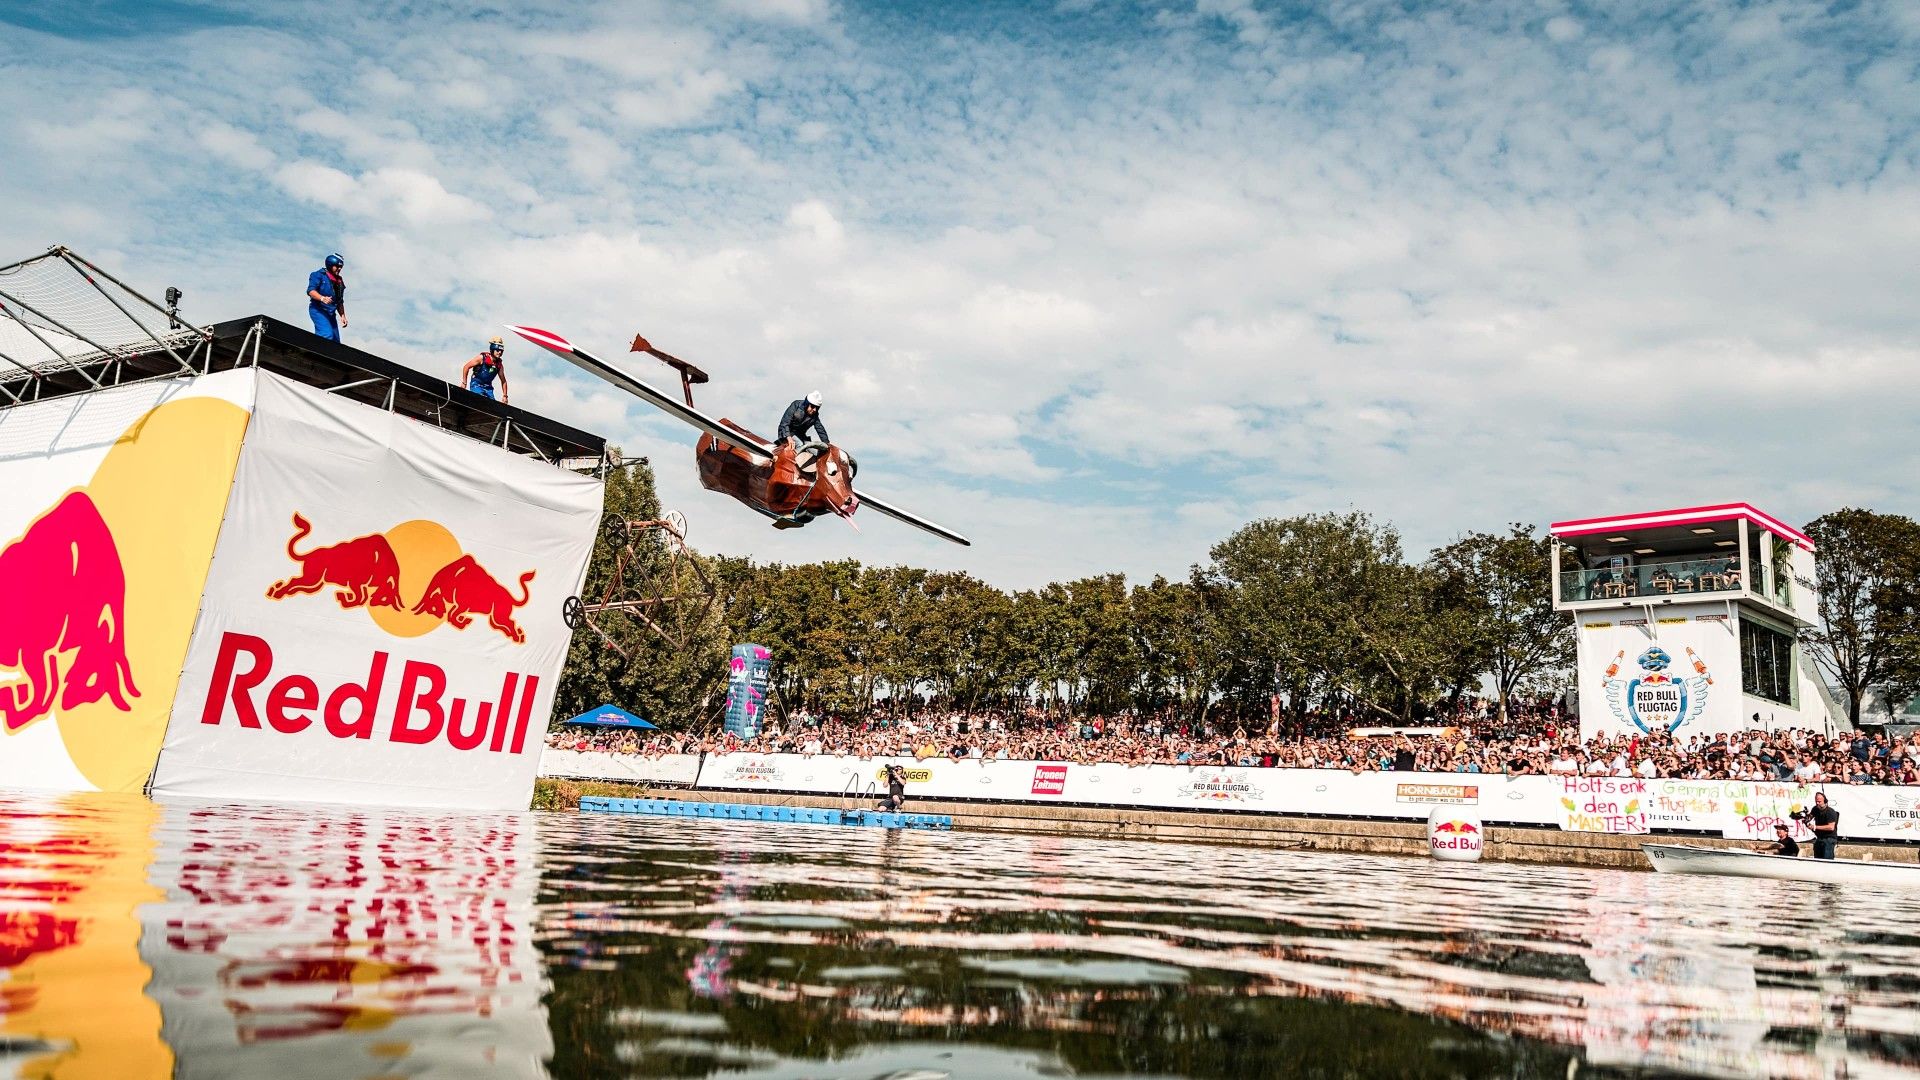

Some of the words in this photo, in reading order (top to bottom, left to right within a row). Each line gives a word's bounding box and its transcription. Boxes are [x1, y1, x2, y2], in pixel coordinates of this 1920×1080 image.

[201, 631, 389, 740] Red
[389, 659, 540, 754] Bull
[1637, 691, 1654, 701] RED
[1656, 690, 1678, 700] BULL
[1638, 702, 1678, 712] FLUGTAG
[879, 770, 929, 780] PNGER
[1035, 769, 1066, 780] Kronen
[1033, 780, 1064, 791] Zeitung
[1206, 783, 1221, 791] BULL
[1222, 784, 1250, 792] FLUGTAG
[1620, 780, 1647, 794] enk
[1662, 780, 1720, 799] Gemma
[1400, 786, 1464, 797] HORNBACH
[1584, 795, 1618, 813] den
[1889, 809, 1907, 819] RED
[1431, 837, 1457, 849] Red
[1459, 837, 1482, 850] Bull
[1653, 850, 1665, 859] 63
